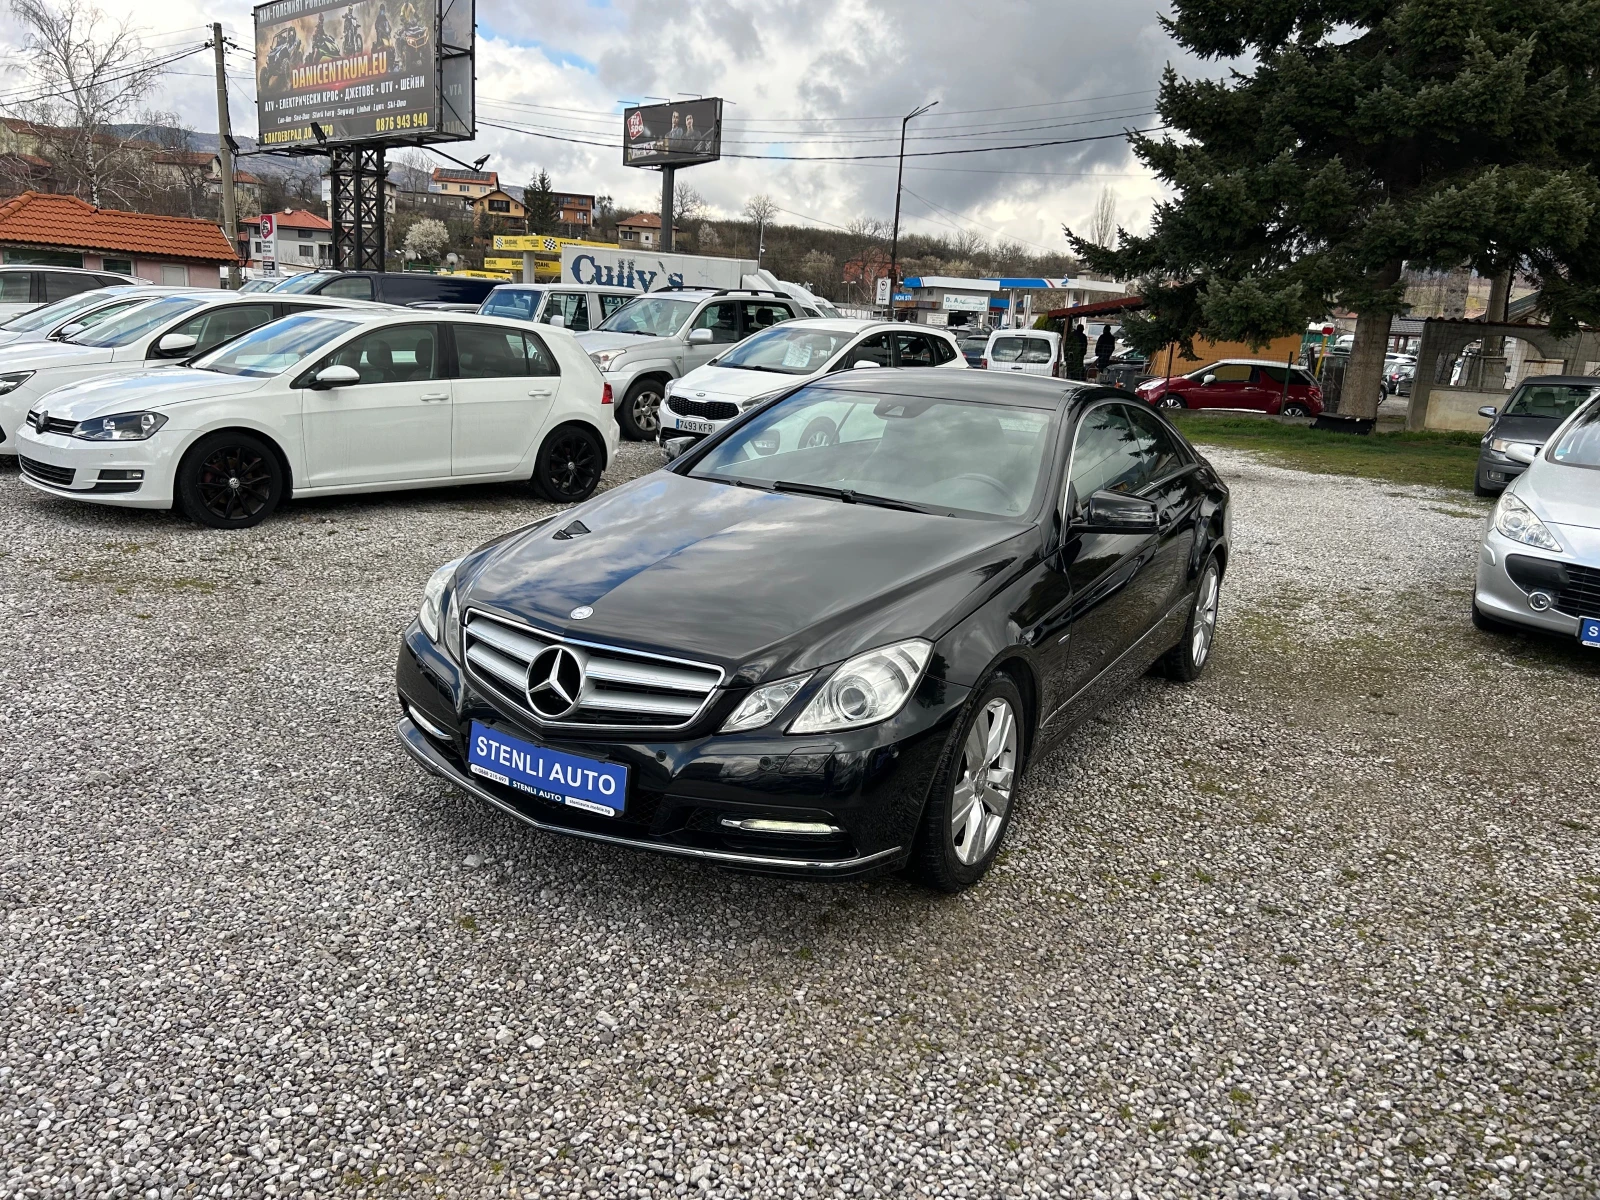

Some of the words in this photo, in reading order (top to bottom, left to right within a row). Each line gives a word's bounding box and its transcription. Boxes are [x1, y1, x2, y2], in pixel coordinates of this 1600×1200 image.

[292, 51, 387, 88] DANICENTRUM.EU
[265, 101, 275, 112] ATV
[322, 90, 339, 102] КРОС
[344, 84, 374, 101] ДЖЕТОВЕ
[400, 75, 425, 90] ШЕЙНИ
[376, 116, 394, 131] 0876
[396, 114, 410, 129] 943
[413, 112, 428, 127] 940
[264, 129, 302, 144] БЛАГОЕВГРАД
[304, 127, 312, 141] ДО
[680, 420, 697, 431] 7493
[698, 423, 713, 433] KFR
[476, 736, 543, 778] STENLI
[549, 763, 616, 795] AUTO
[512, 780, 537, 795] STENLI
[538, 790, 562, 802] AUTO
